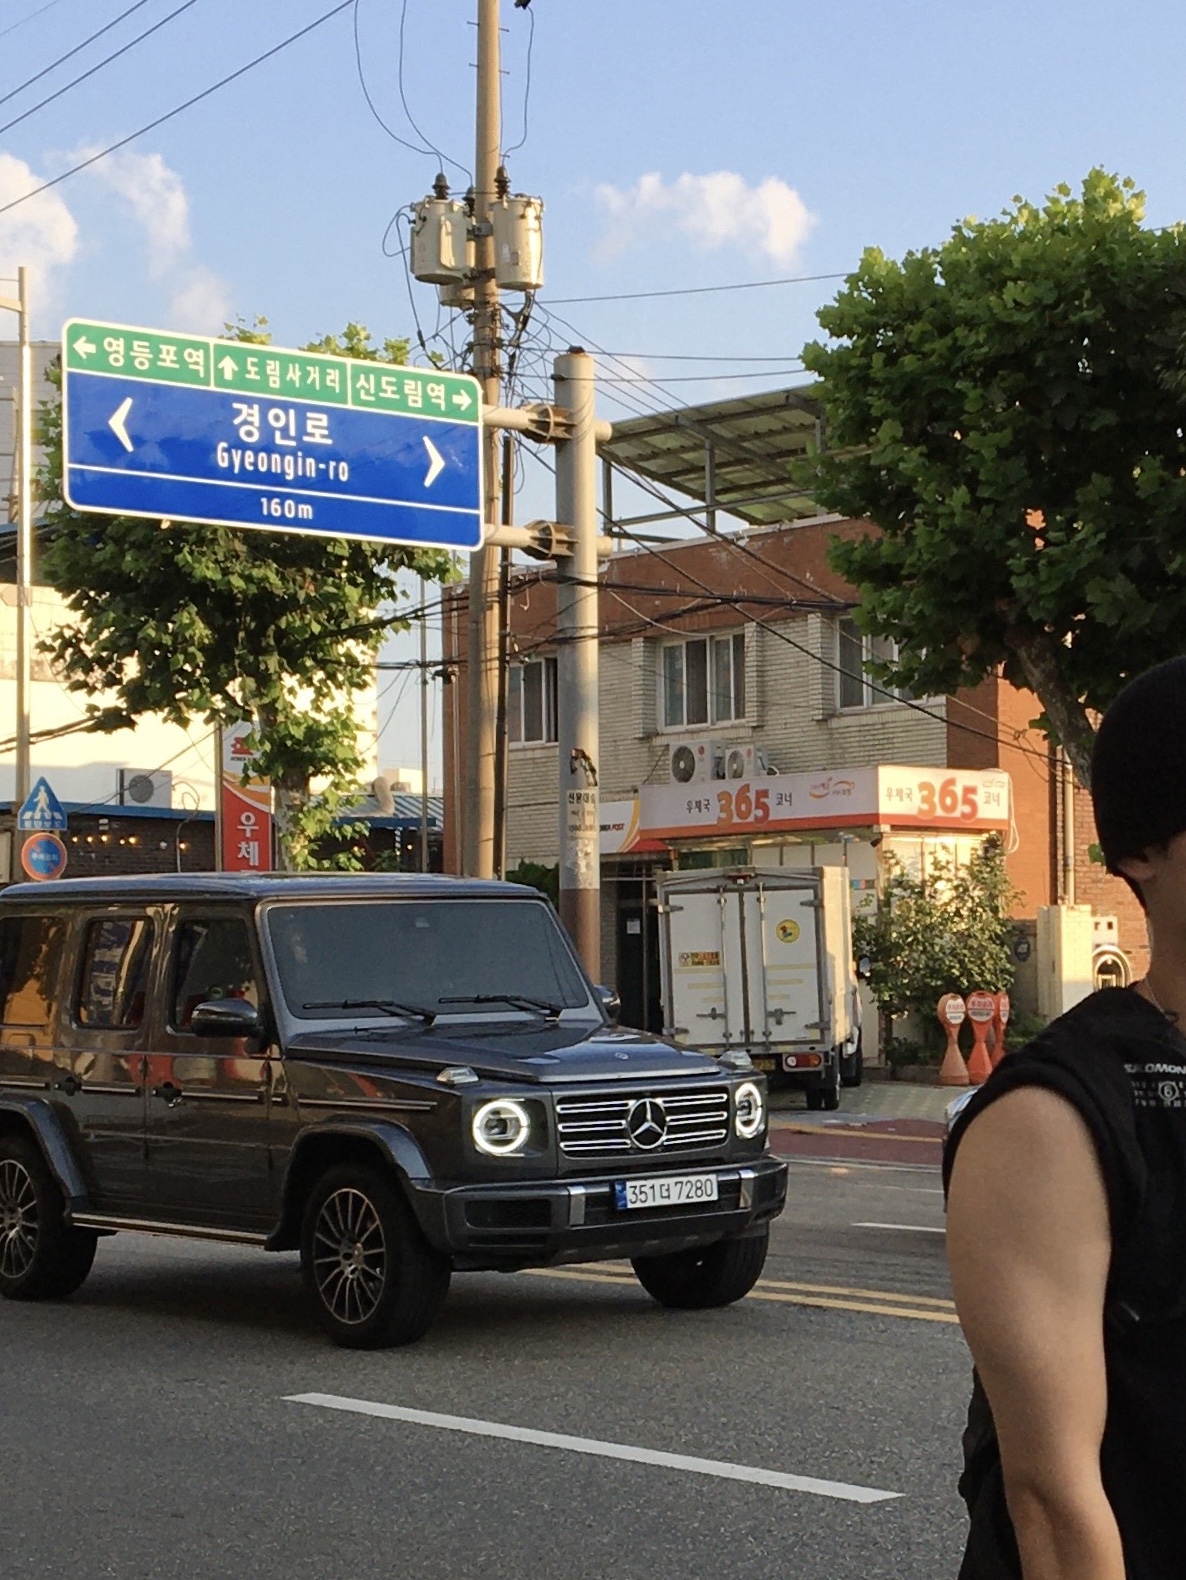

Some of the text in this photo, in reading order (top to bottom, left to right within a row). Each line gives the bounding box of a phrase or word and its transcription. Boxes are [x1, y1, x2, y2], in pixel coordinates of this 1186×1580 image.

[103, 337, 206, 378] 영등포역
[244, 358, 340, 393] 도림사거리
[356, 377, 446, 411] 신도림역
[232, 402, 333, 446] 경인로
[216, 441, 349, 482] Gyeongin-ro
[260, 497, 314, 520] 160m
[686, 783, 793, 829] 우체국 365 코너
[916, 777, 979, 822] 365
[237, 811, 260, 872] 우체
[628, 1179, 714, 1205] 351더 7280
